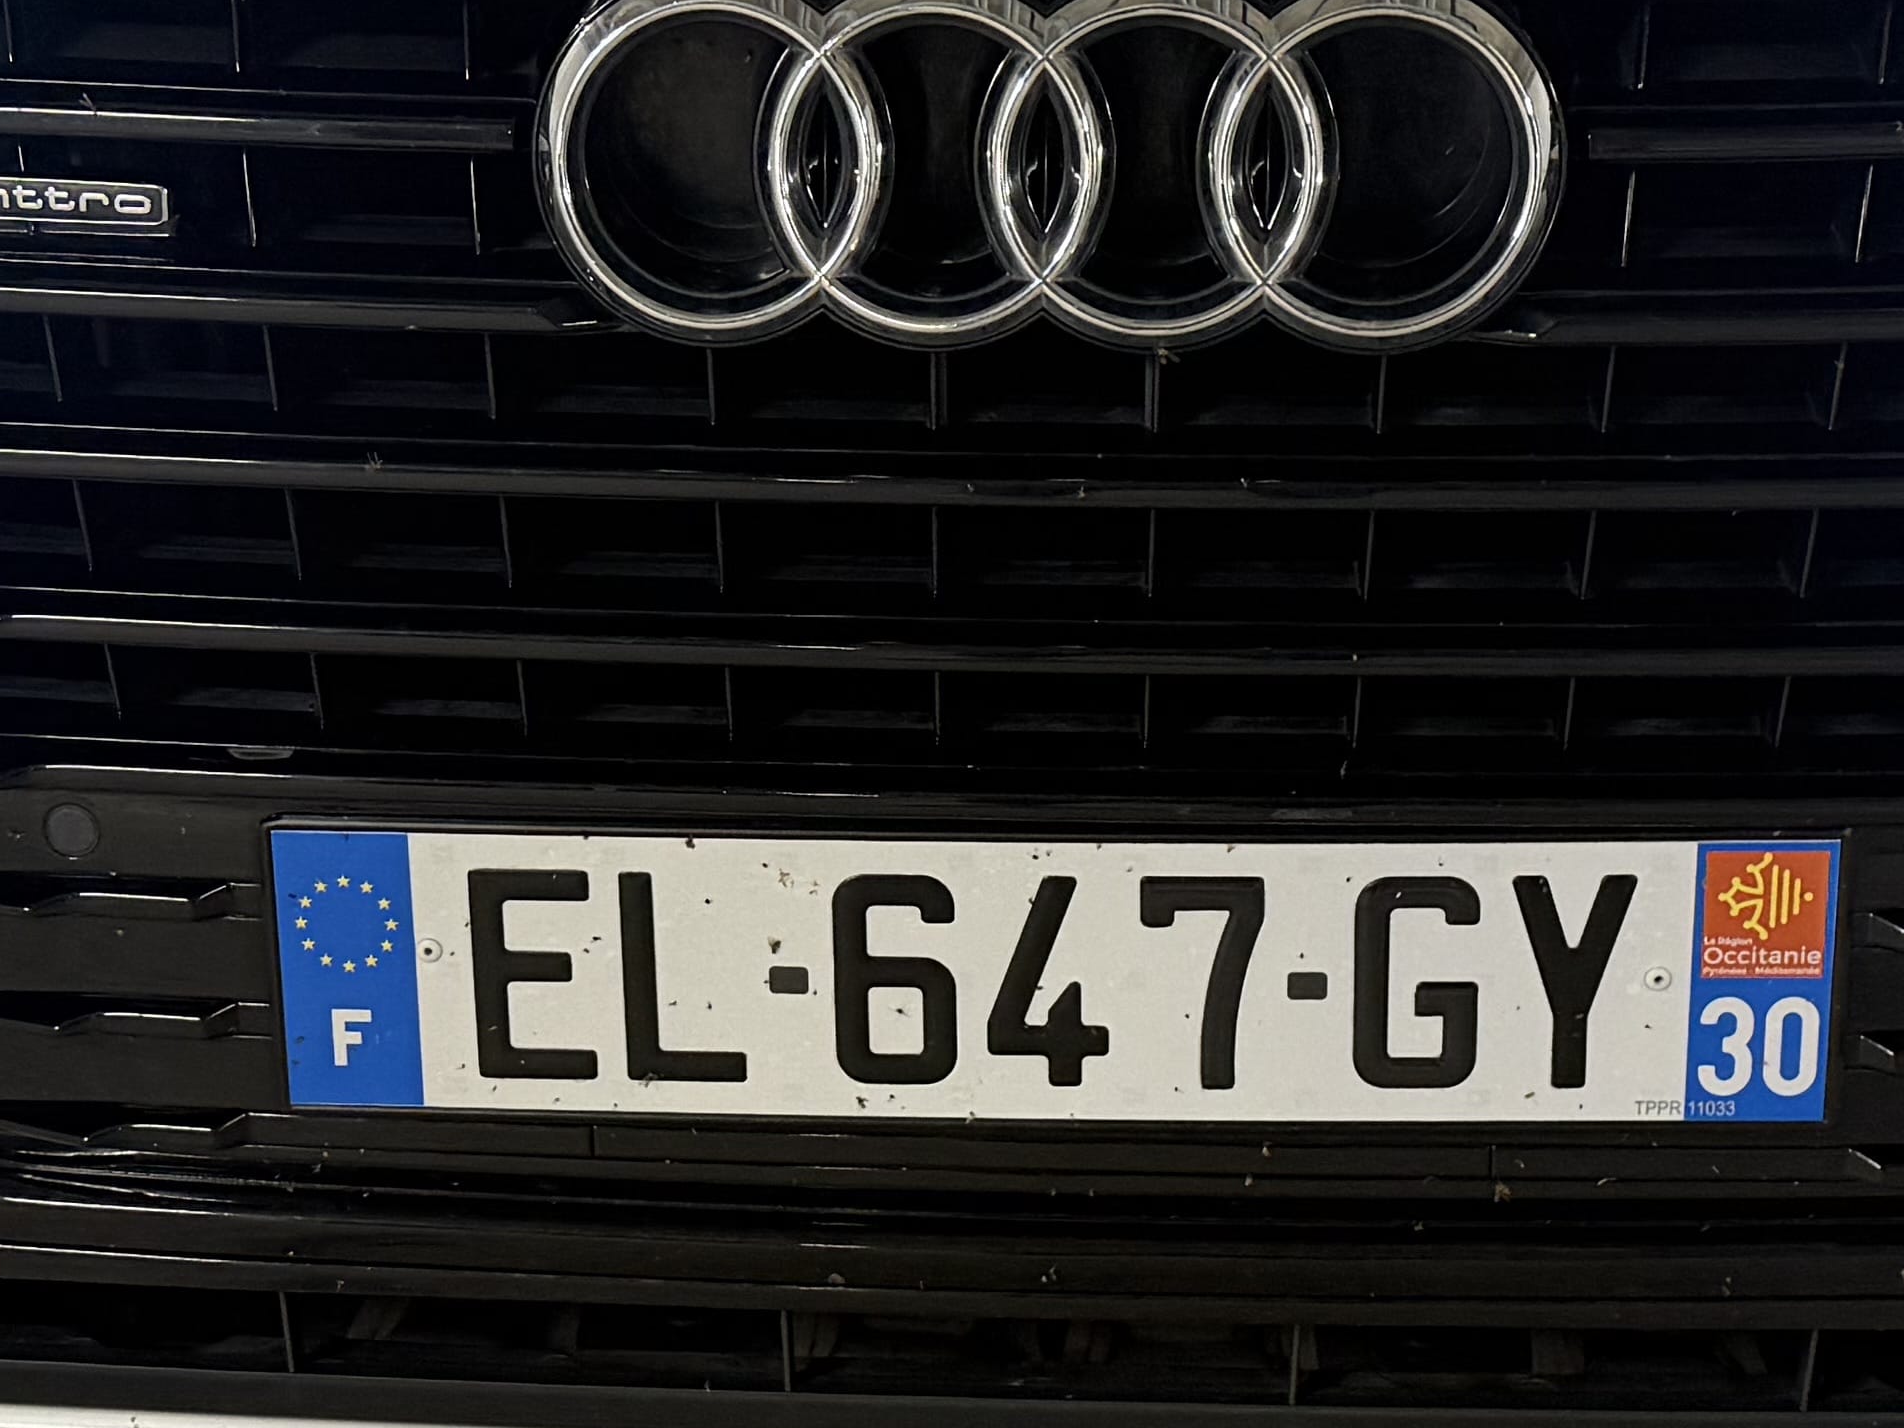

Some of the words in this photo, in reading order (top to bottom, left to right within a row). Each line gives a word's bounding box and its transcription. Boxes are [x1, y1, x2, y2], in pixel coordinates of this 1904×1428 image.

[468, 868, 1638, 1090] EL-647-GY
[1703, 945, 1822, 965] Occitanie
[331, 1008, 373, 1067] F
[1697, 996, 1820, 1097] 30
[1634, 1099, 1682, 1116] TPPR
[1687, 1100, 1736, 1117] 11033
